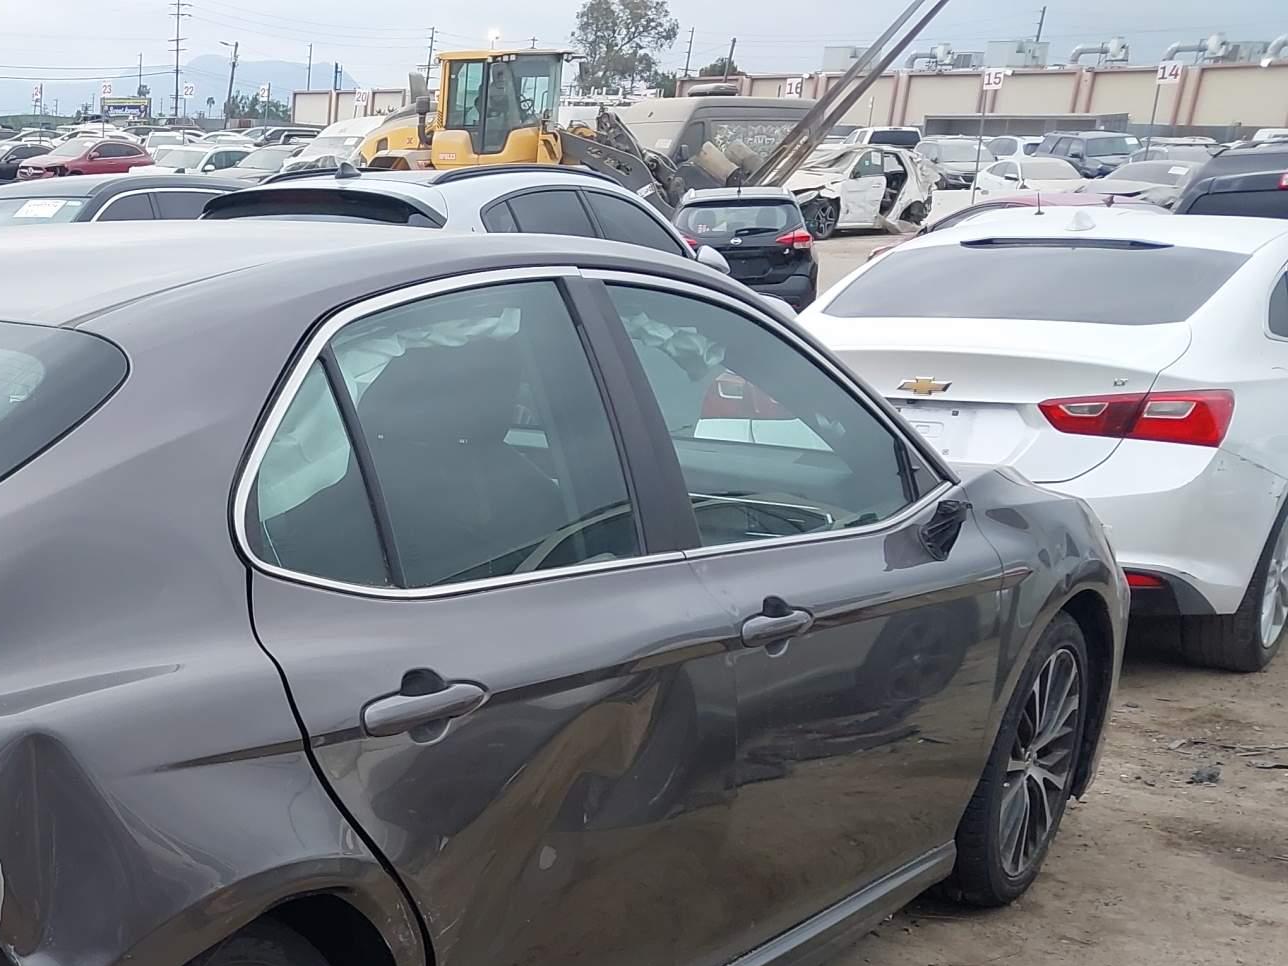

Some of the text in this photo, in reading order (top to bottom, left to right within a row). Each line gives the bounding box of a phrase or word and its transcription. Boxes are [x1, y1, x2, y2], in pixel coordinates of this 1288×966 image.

[1158, 64, 1179, 80] 14
[985, 71, 1002, 86] 15
[102, 84, 112, 95] 23
[184, 86, 194, 96] 22
[356, 91, 368, 102] 20
